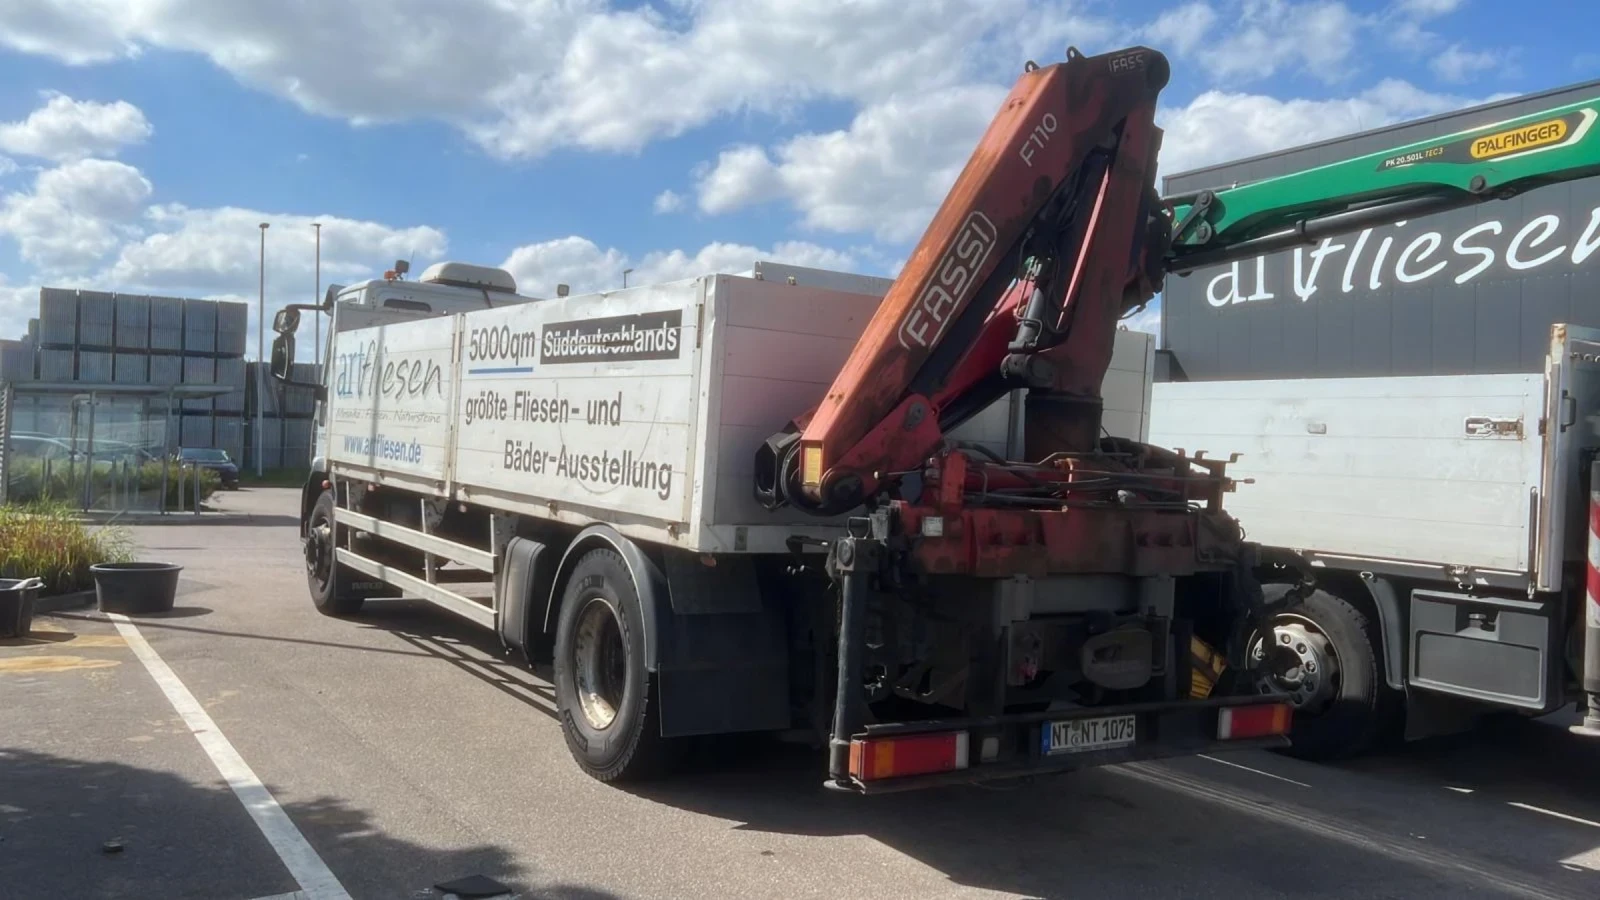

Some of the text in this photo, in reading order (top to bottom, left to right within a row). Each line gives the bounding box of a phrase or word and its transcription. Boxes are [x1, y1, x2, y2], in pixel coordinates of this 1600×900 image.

[1019, 113, 1057, 167] F110
[1385, 159, 1396, 167] PK
[1396, 152, 1424, 165] 20.501L
[1476, 123, 1560, 155] PALFINGER
[906, 221, 991, 347] FASSI
[469, 321, 677, 366] 5000qm Süddeutschlands
[336, 339, 442, 400] artfliesen
[465, 390, 507, 426] größte
[587, 391, 622, 426] und
[503, 439, 673, 501] Bäder-Ausstellung
[1052, 717, 1134, 747] NT NT 1075
